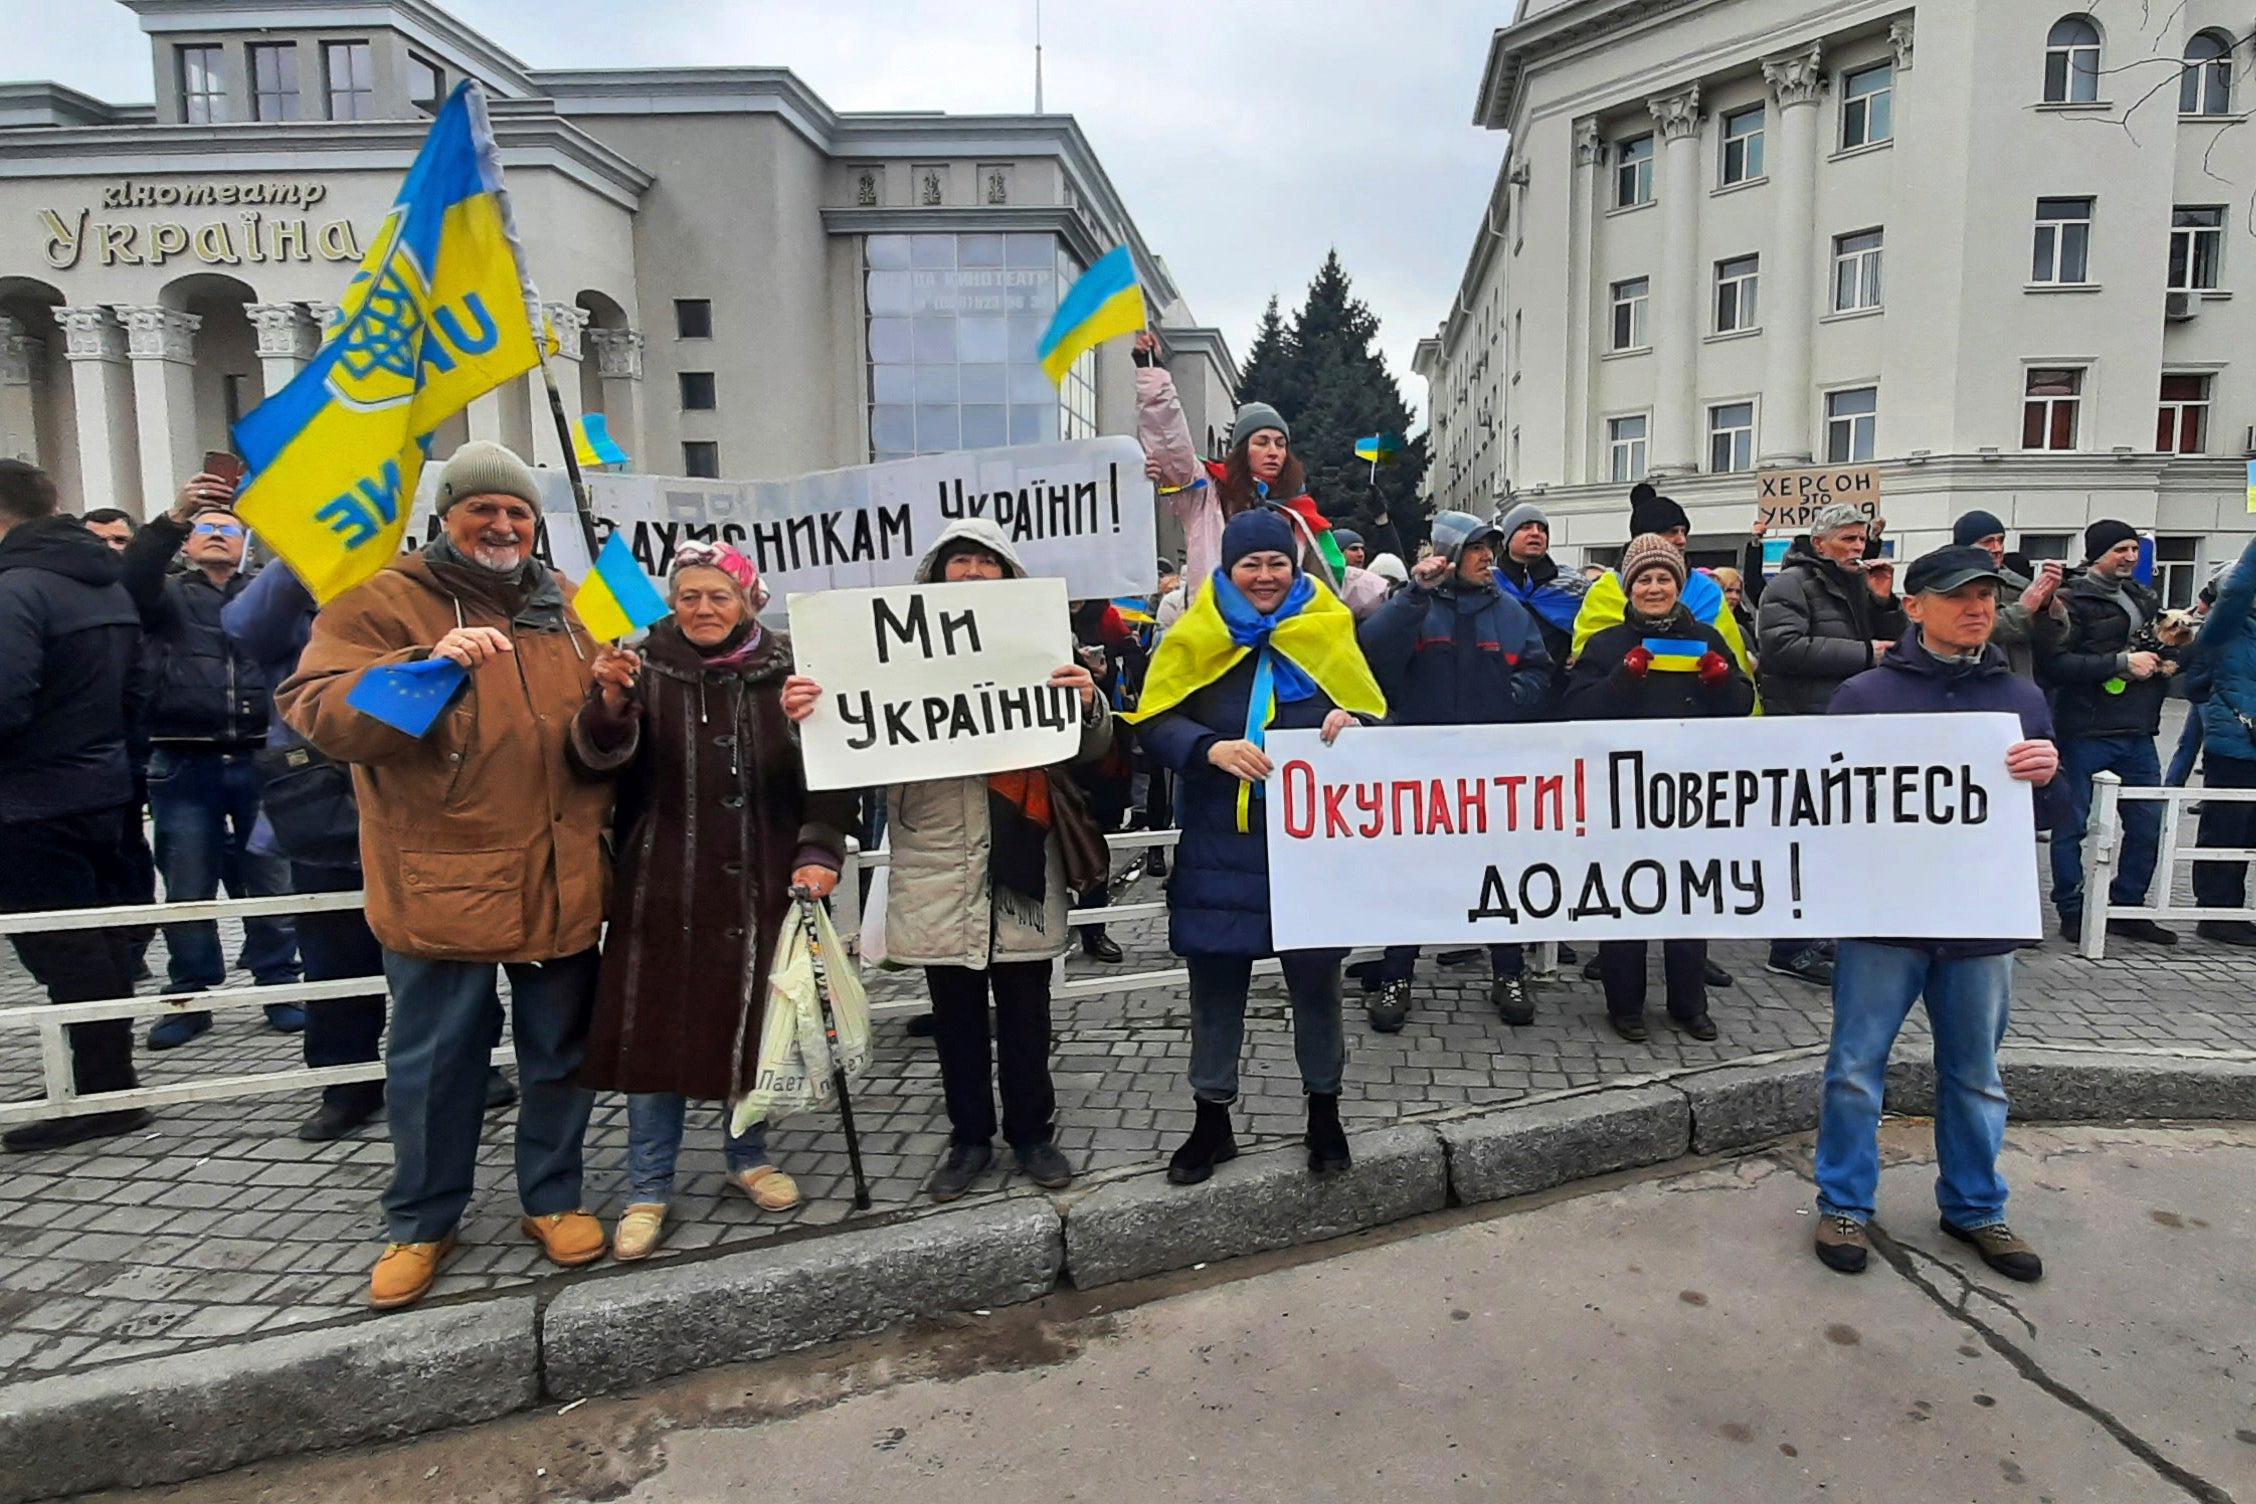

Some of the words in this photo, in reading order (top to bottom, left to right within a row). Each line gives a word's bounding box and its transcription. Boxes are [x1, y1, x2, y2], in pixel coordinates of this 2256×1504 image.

[101, 180, 327, 212] кінотеатр
[37, 207, 366, 269] Україна
[1761, 472, 1871, 498] ХЕРСОН
[1800, 493, 1832, 506] ЭТО
